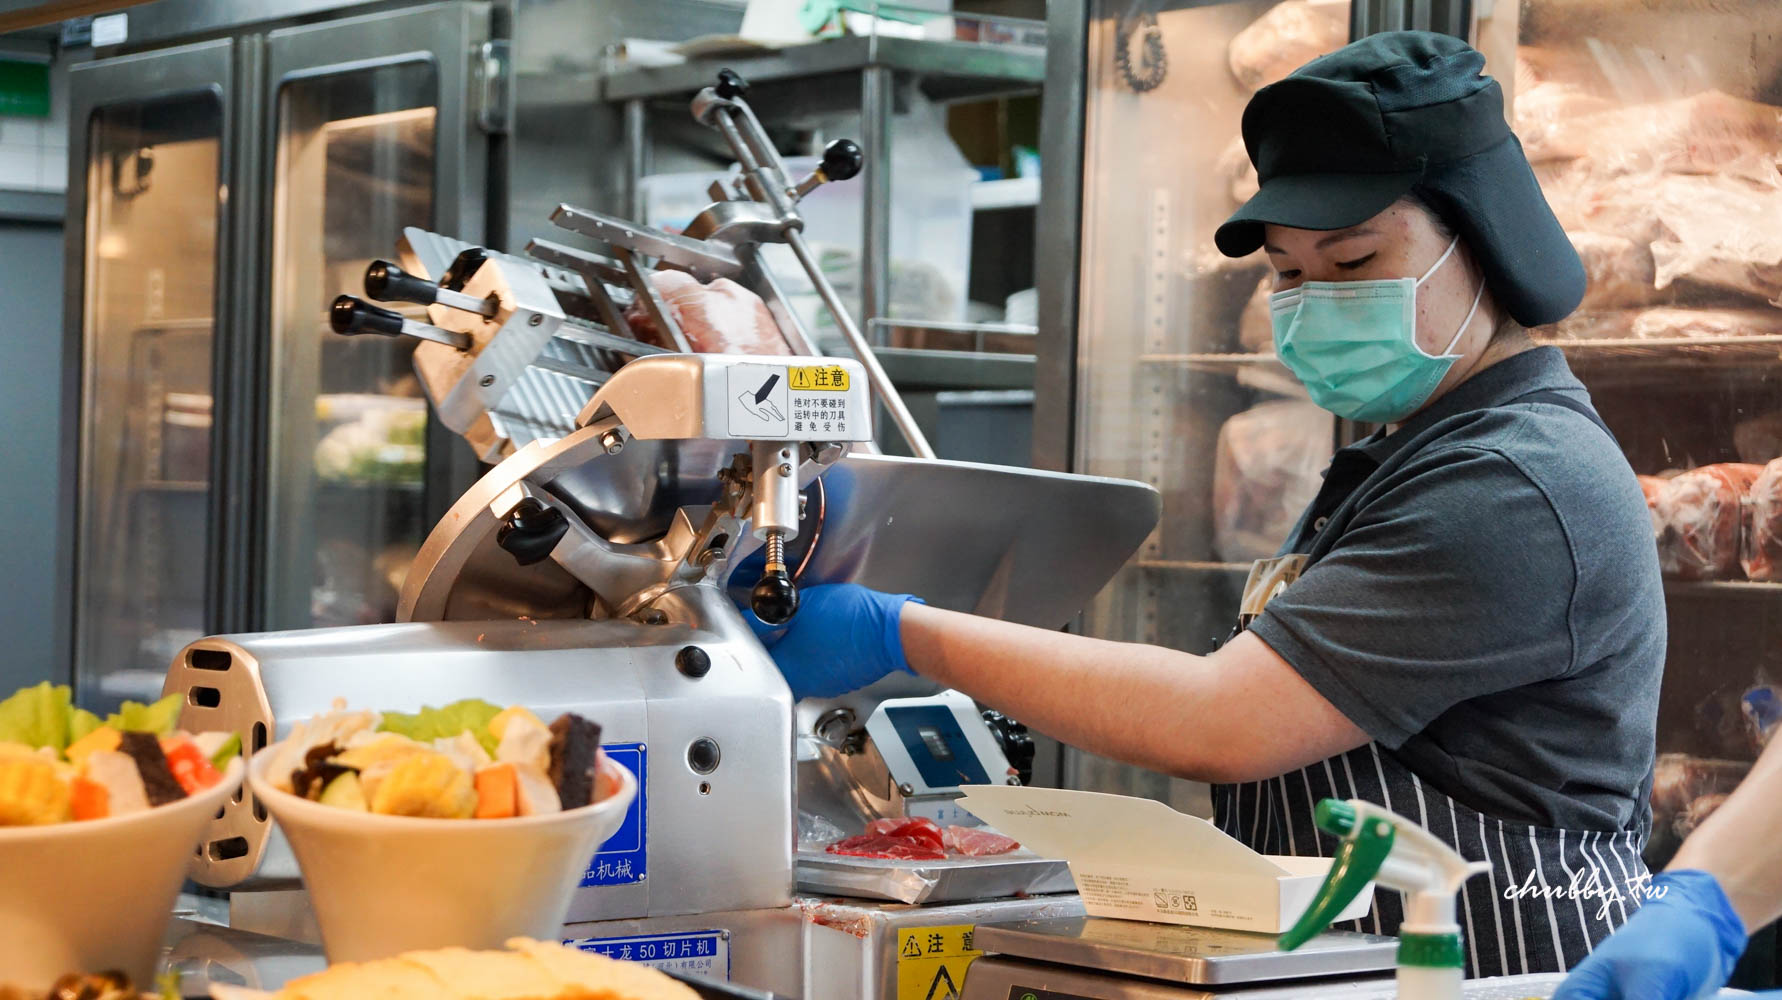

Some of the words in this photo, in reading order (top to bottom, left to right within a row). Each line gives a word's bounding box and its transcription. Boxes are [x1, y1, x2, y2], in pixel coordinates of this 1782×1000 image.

[814, 368, 845, 387] 注意
[794, 398, 846, 409] 绝对不要碰到
[794, 410, 846, 420] 运转中的刀具
[794, 422, 846, 432] 避免受伤
